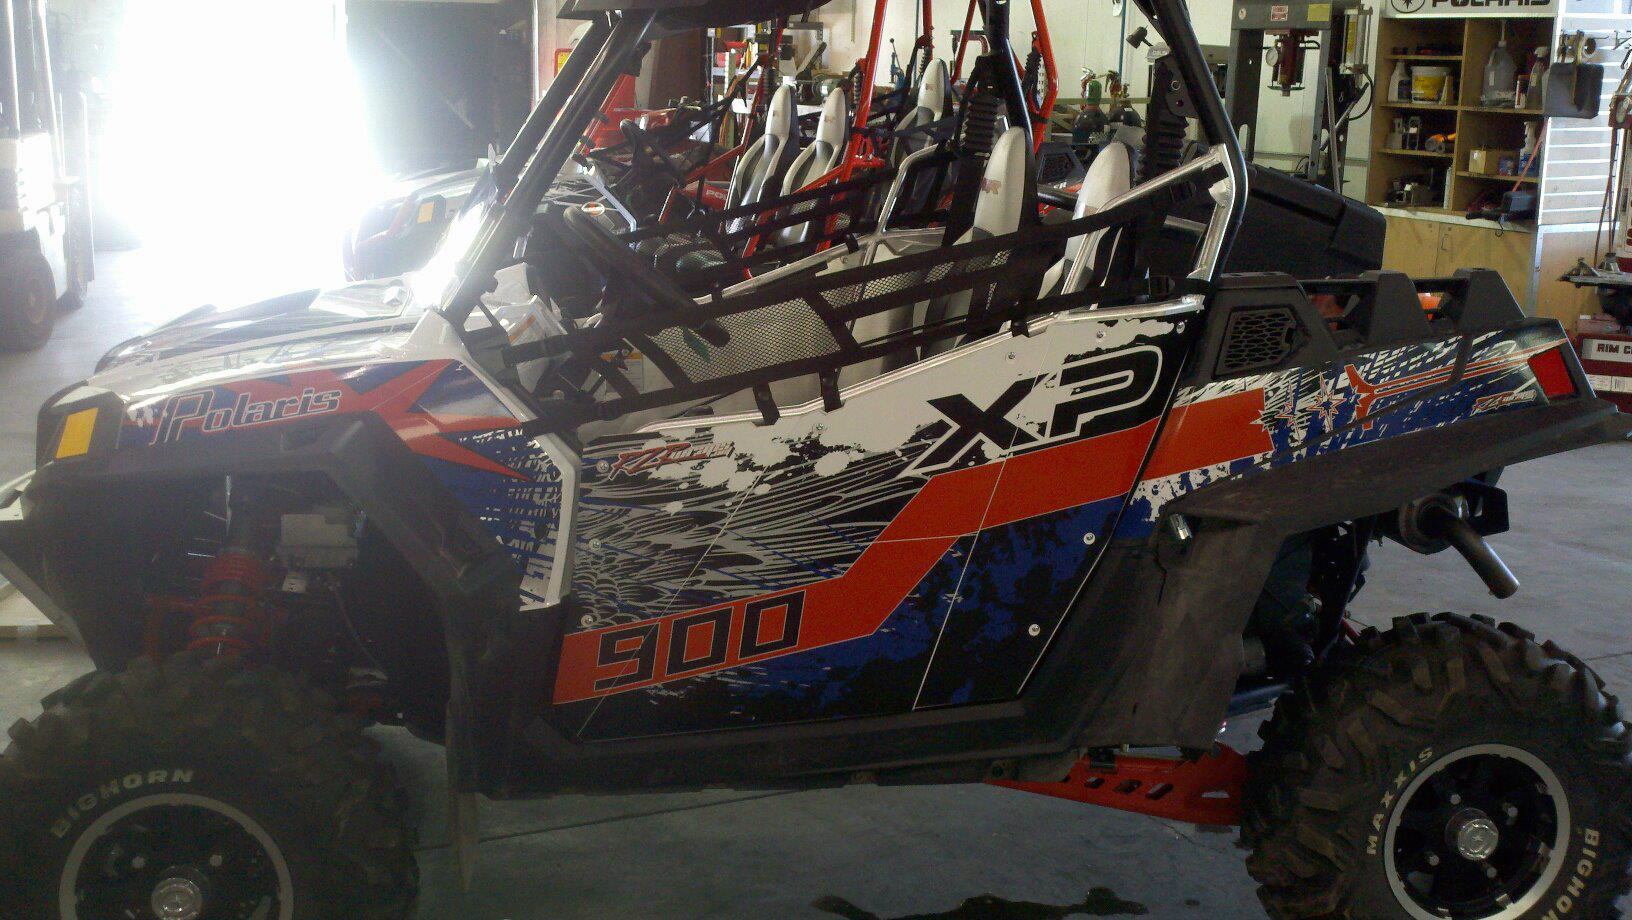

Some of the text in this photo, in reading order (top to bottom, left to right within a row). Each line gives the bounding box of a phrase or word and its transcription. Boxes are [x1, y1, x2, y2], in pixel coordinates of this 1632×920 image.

[1596, 343, 1620, 353] RIM
[149, 387, 342, 446] Polaris
[898, 345, 1163, 475] XP
[594, 590, 806, 691] 900
[51, 769, 194, 838] BIGHORN
[1366, 747, 1434, 855] MAXXIS
